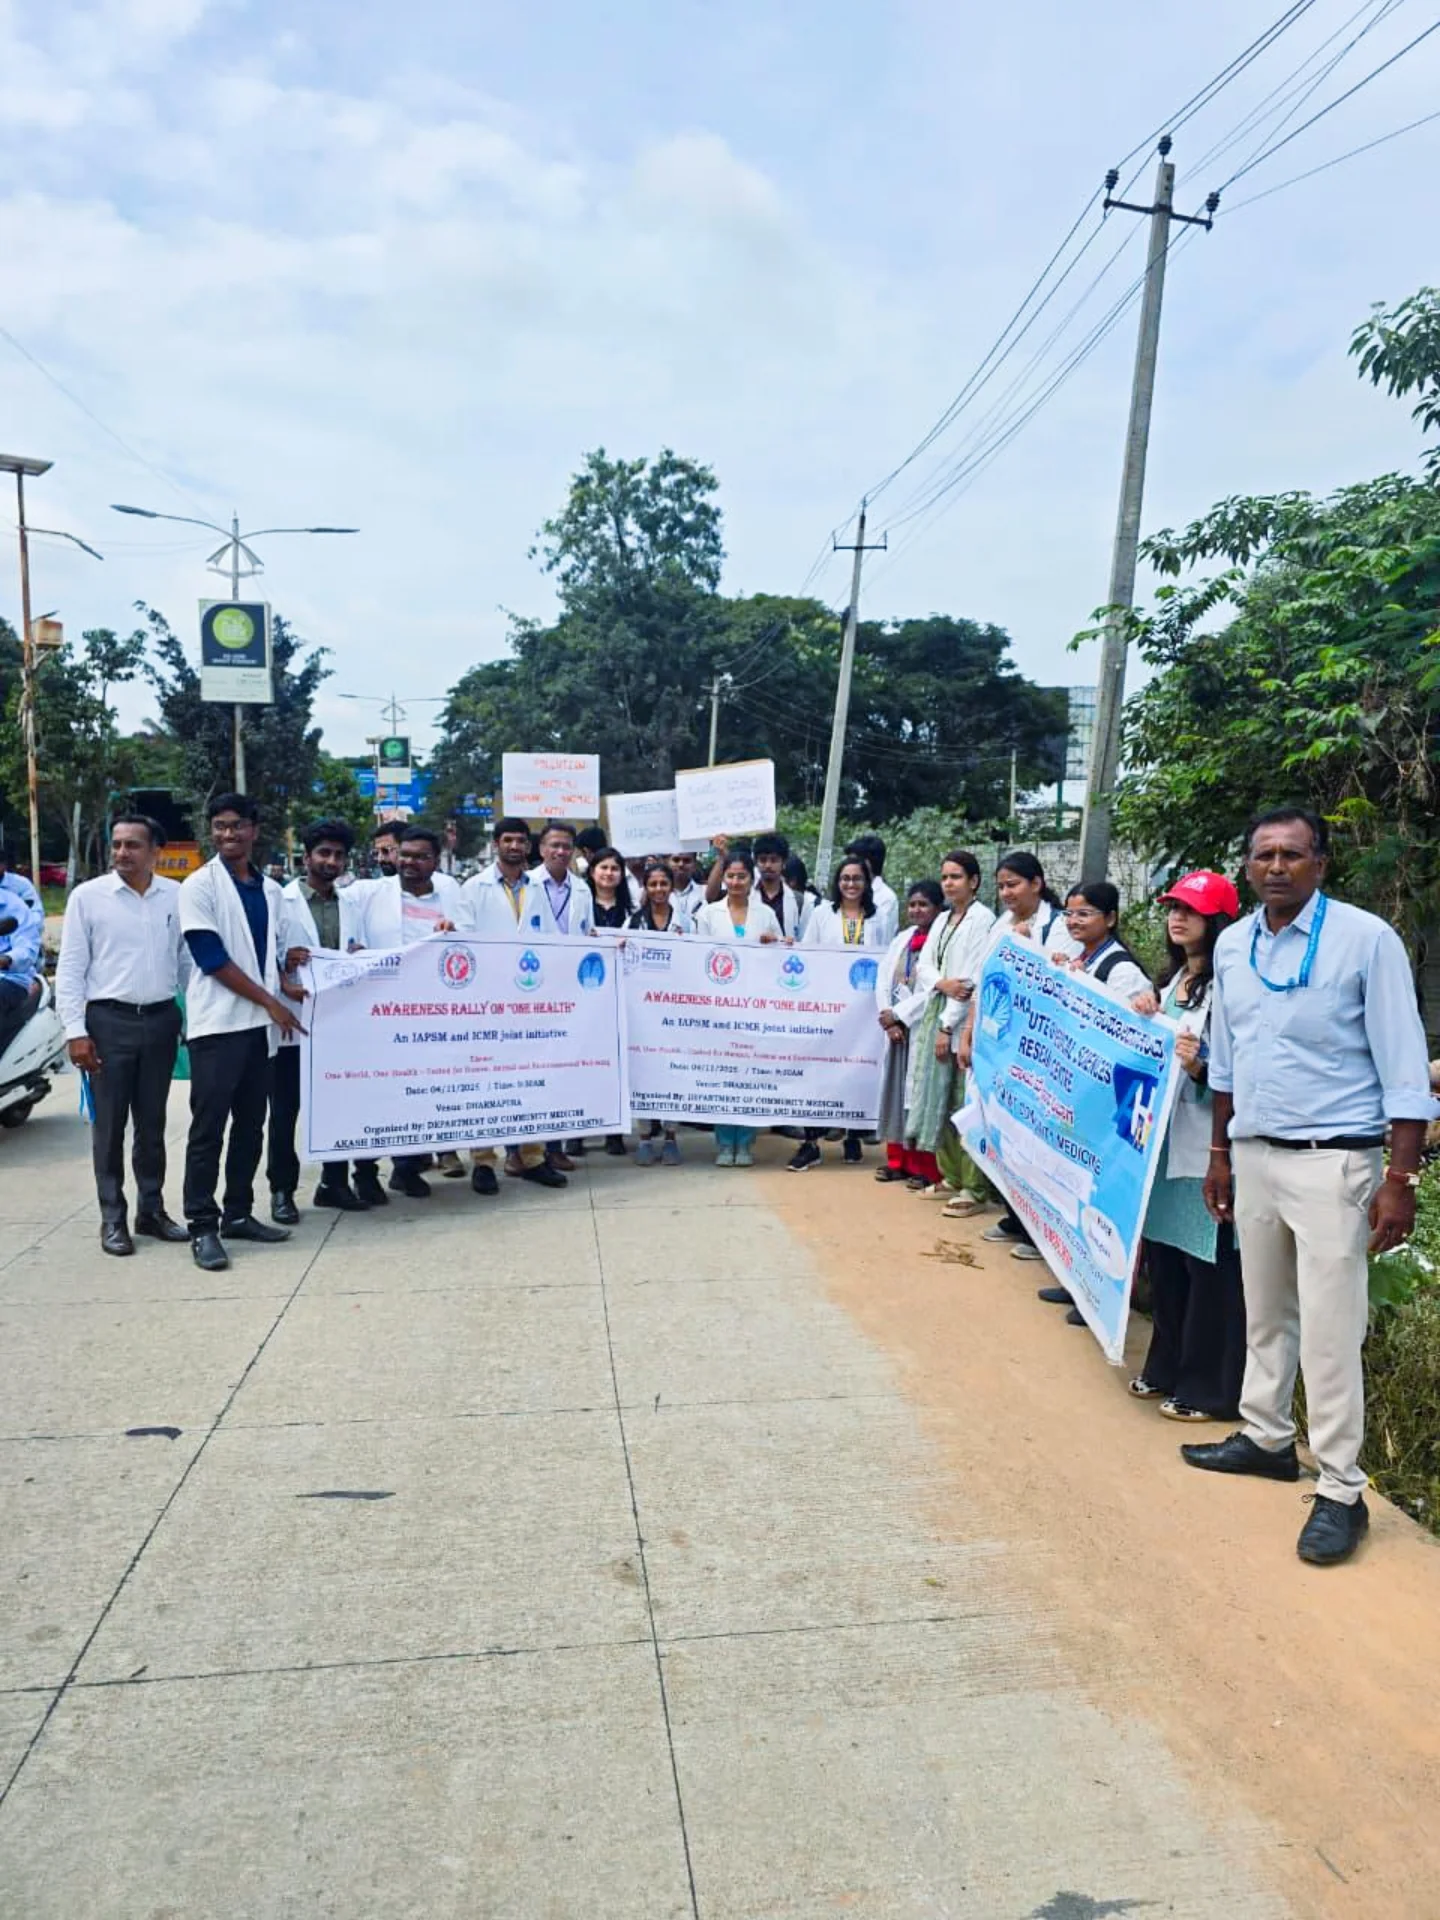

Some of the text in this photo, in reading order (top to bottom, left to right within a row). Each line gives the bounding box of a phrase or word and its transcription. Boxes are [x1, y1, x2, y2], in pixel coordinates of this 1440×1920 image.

[371, 1001, 448, 1016] AWARENESS
[451, 1000, 487, 1015] RALLY
[490, 1002, 505, 1014] ON
[644, 991, 711, 1005] AWARENESS
[714, 996, 751, 1008] RALLY
[752, 998, 767, 1009] ON
[661, 1017, 834, 1035] An IAPSM and ICMR joint initiative
[393, 1029, 568, 1043] An IAPSM and ICMR joint initiative
[405, 1086, 428, 1096] Date:
[435, 1103, 463, 1112] Venue:
[687, 1093, 741, 1103] DEPARTMENT
[743, 1095, 754, 1103] OF
[755, 1096, 804, 1107] COMMUNITY
[806, 1099, 845, 1108] MEDICINE
[637, 1101, 679, 1110] INSTITUTE
[773, 1106, 789, 1115] AND
[791, 1107, 833, 1117] RESEARCH
[364, 1123, 409, 1135] Organized
[427, 1117, 484, 1129] DEPARTMENT
[487, 1116, 498, 1124] OF
[501, 1112, 548, 1123] COMMUNITY
[550, 1109, 584, 1119] MEDICINE
[333, 1138, 368, 1149] AKASH
[371, 1135, 419, 1146] INSTITUTE
[422, 1134, 433, 1142] OF
[436, 1129, 474, 1141] MEDICAL
[477, 1126, 516, 1138] SCIENCES
[518, 1124, 535, 1133] AND
[536, 1121, 575, 1132] RESEARCH
